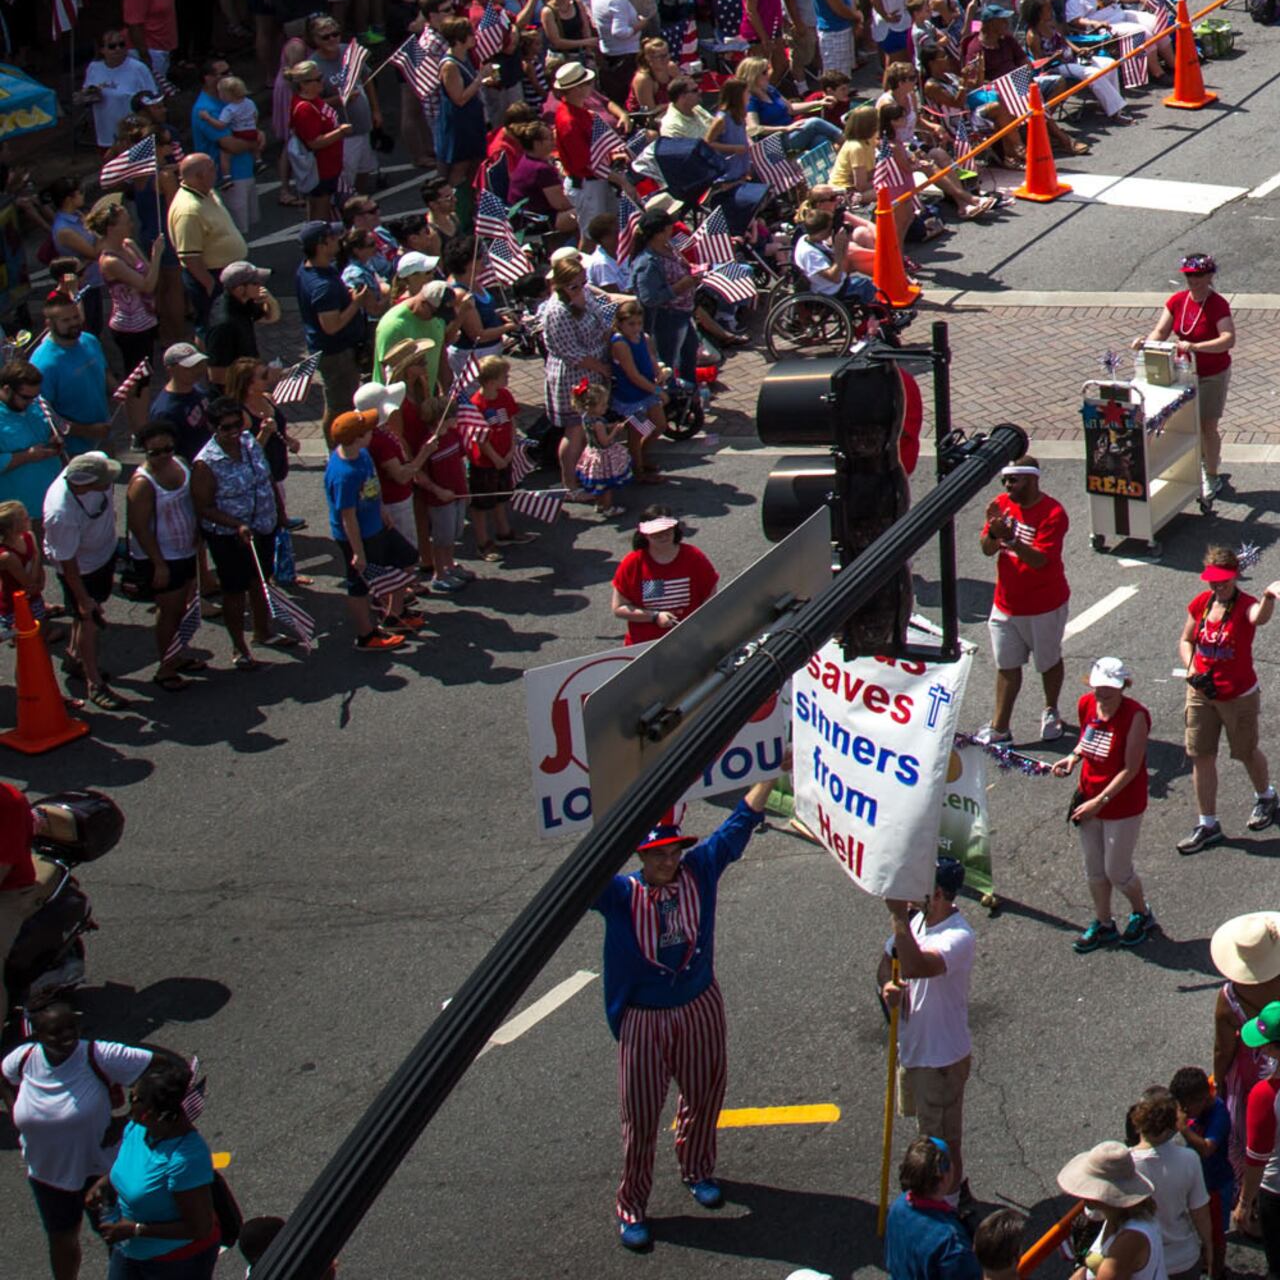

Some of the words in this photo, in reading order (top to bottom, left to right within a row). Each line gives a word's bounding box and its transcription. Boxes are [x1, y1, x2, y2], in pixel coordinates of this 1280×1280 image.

[1088, 475, 1144, 497] READ
[806, 652, 915, 725] saves
[796, 690, 921, 787] sinners
[813, 746, 878, 827] from
[817, 803, 864, 879] Hell
